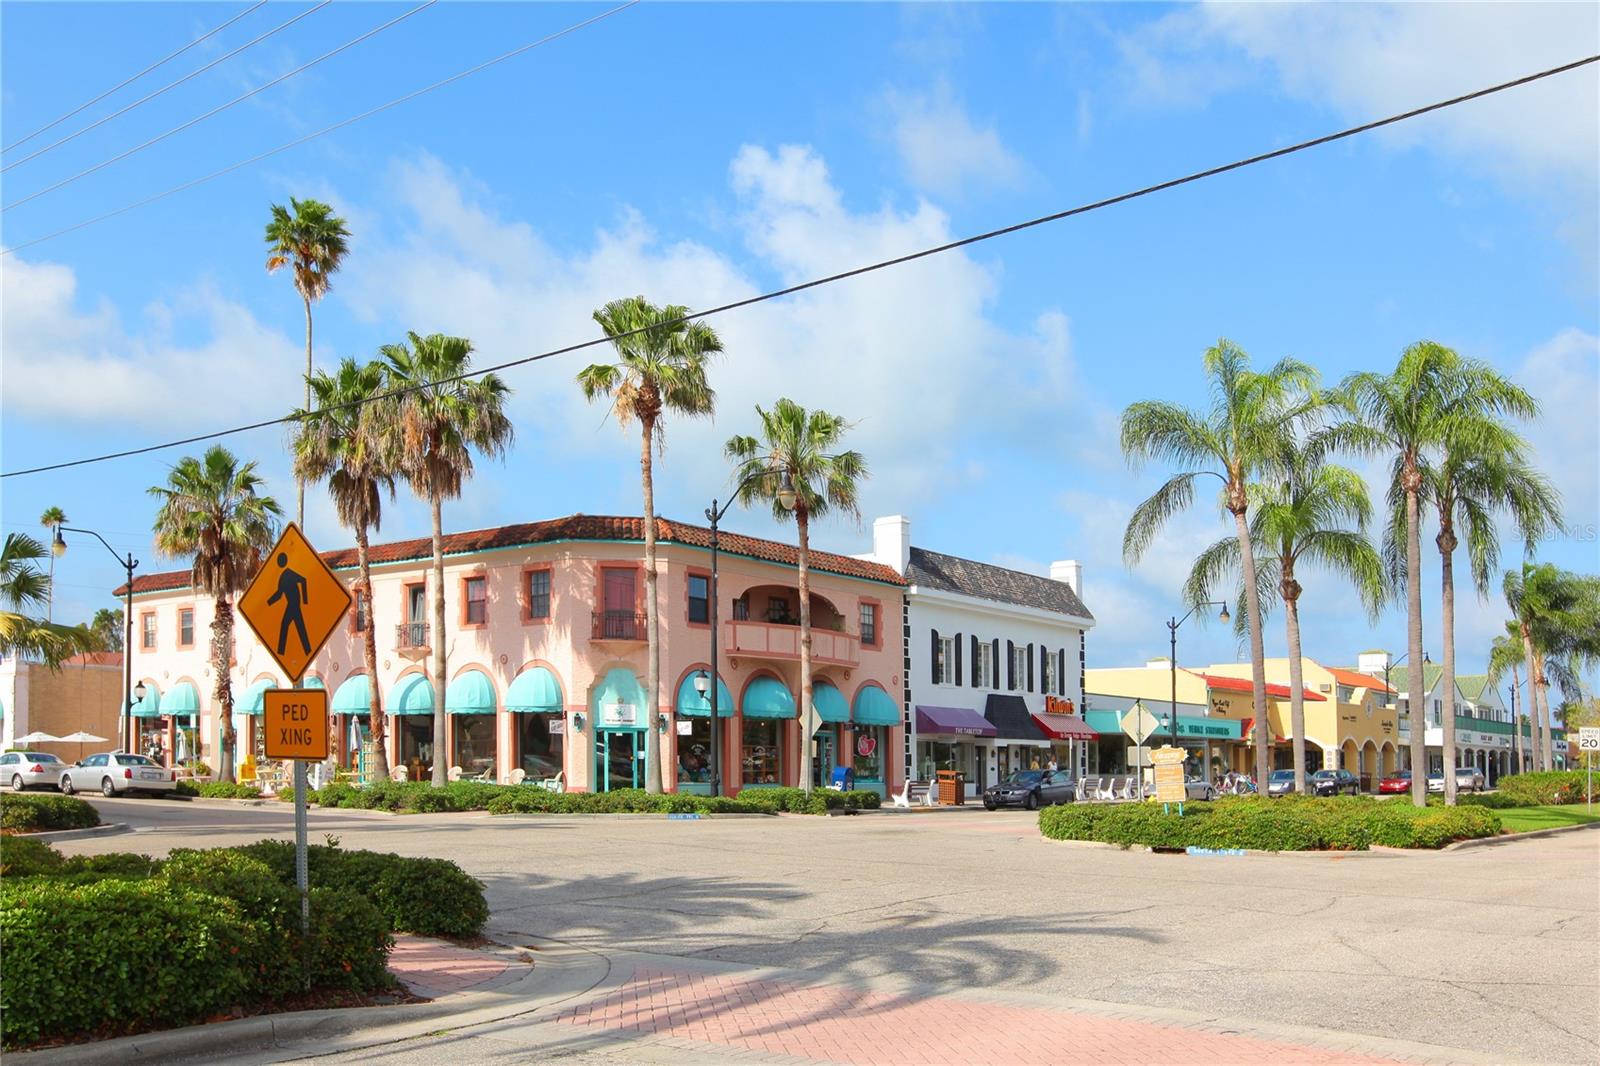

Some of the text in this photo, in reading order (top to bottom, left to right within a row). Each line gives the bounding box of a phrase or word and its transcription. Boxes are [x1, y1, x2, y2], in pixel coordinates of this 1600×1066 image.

[282, 704, 308, 721] PED
[280, 728, 312, 746] XING
[1581, 738, 1598, 748] 20
